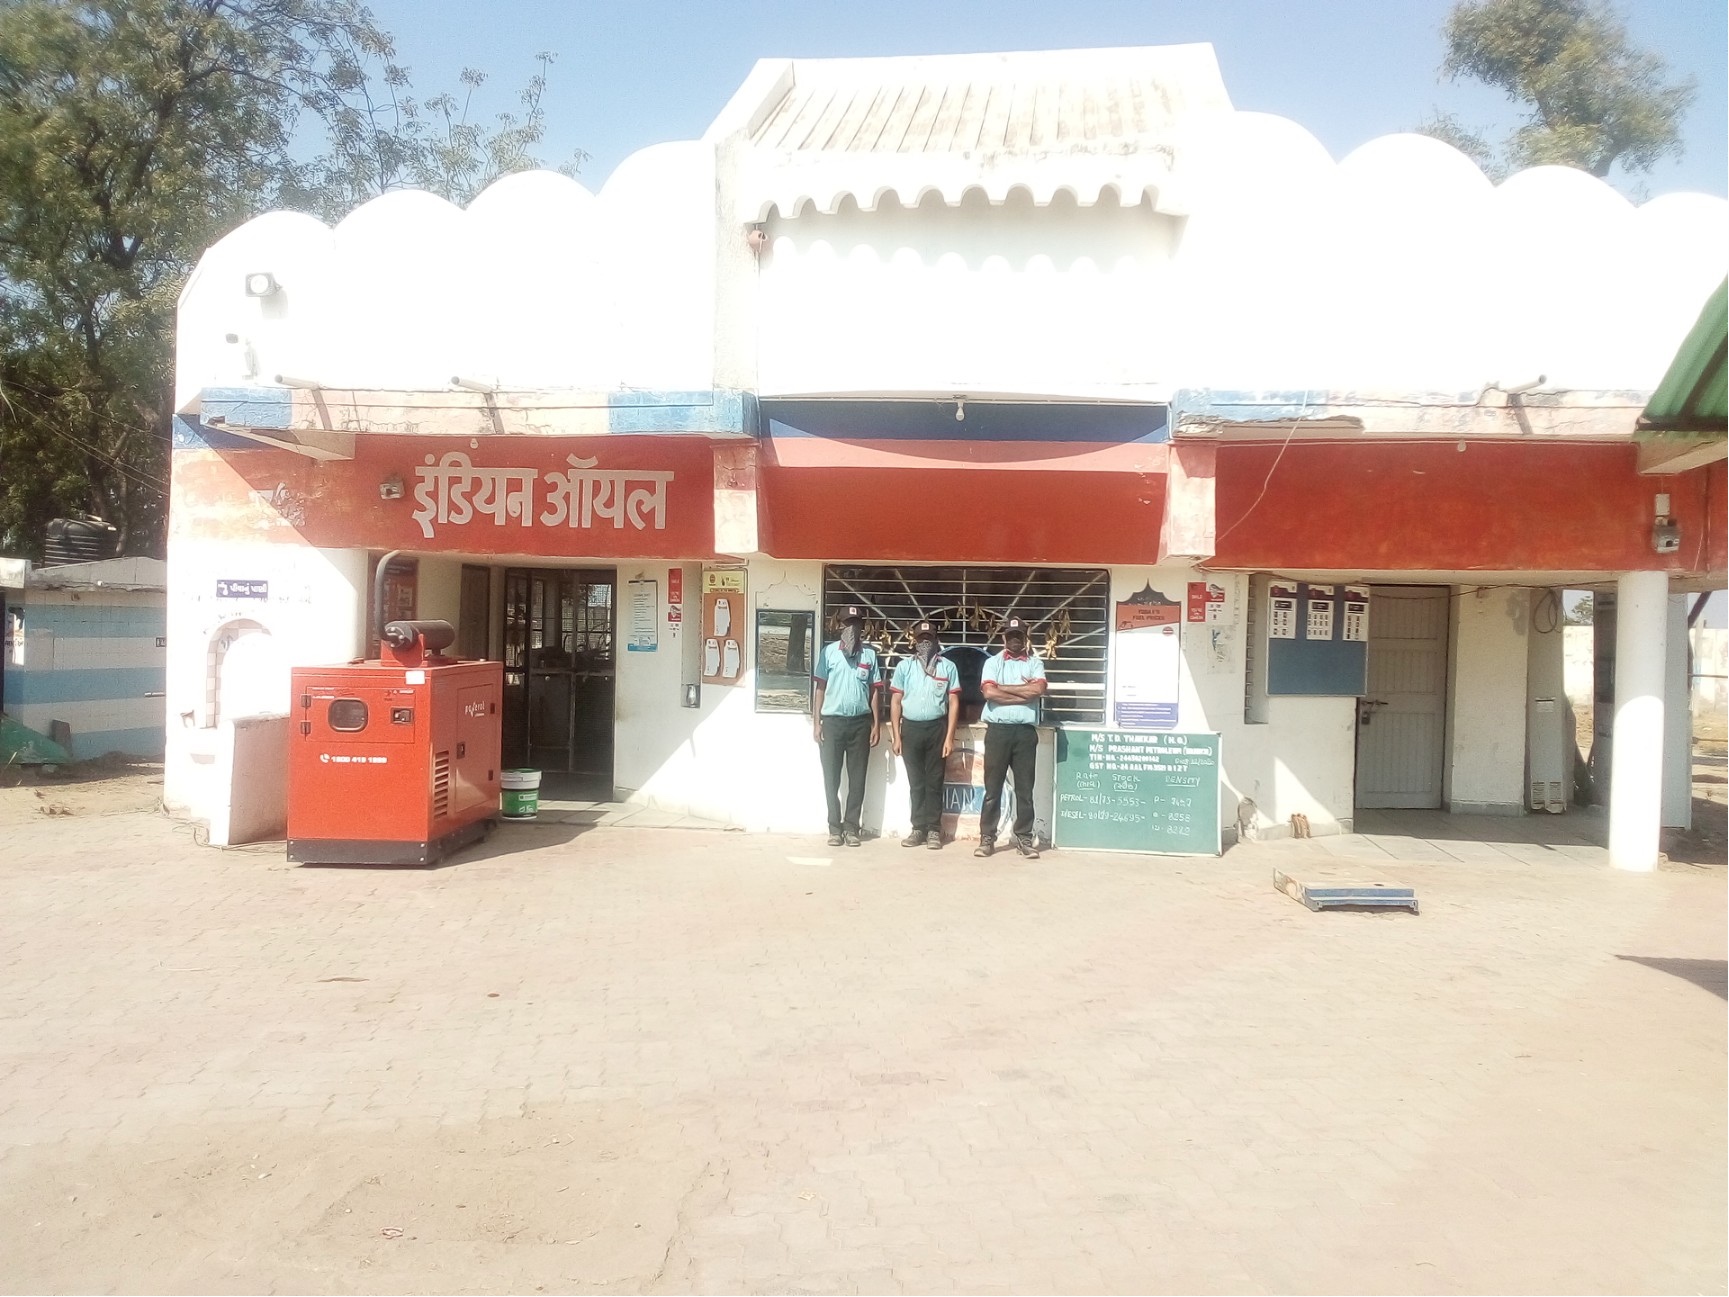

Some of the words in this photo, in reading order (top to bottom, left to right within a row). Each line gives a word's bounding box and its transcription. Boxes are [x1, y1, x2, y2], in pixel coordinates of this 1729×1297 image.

[411, 451, 538, 538] इंडियन
[539, 452, 675, 531] ऑयल
[1108, 745, 1144, 753] PRASHANT
[1112, 773, 1141, 782] STOCK
